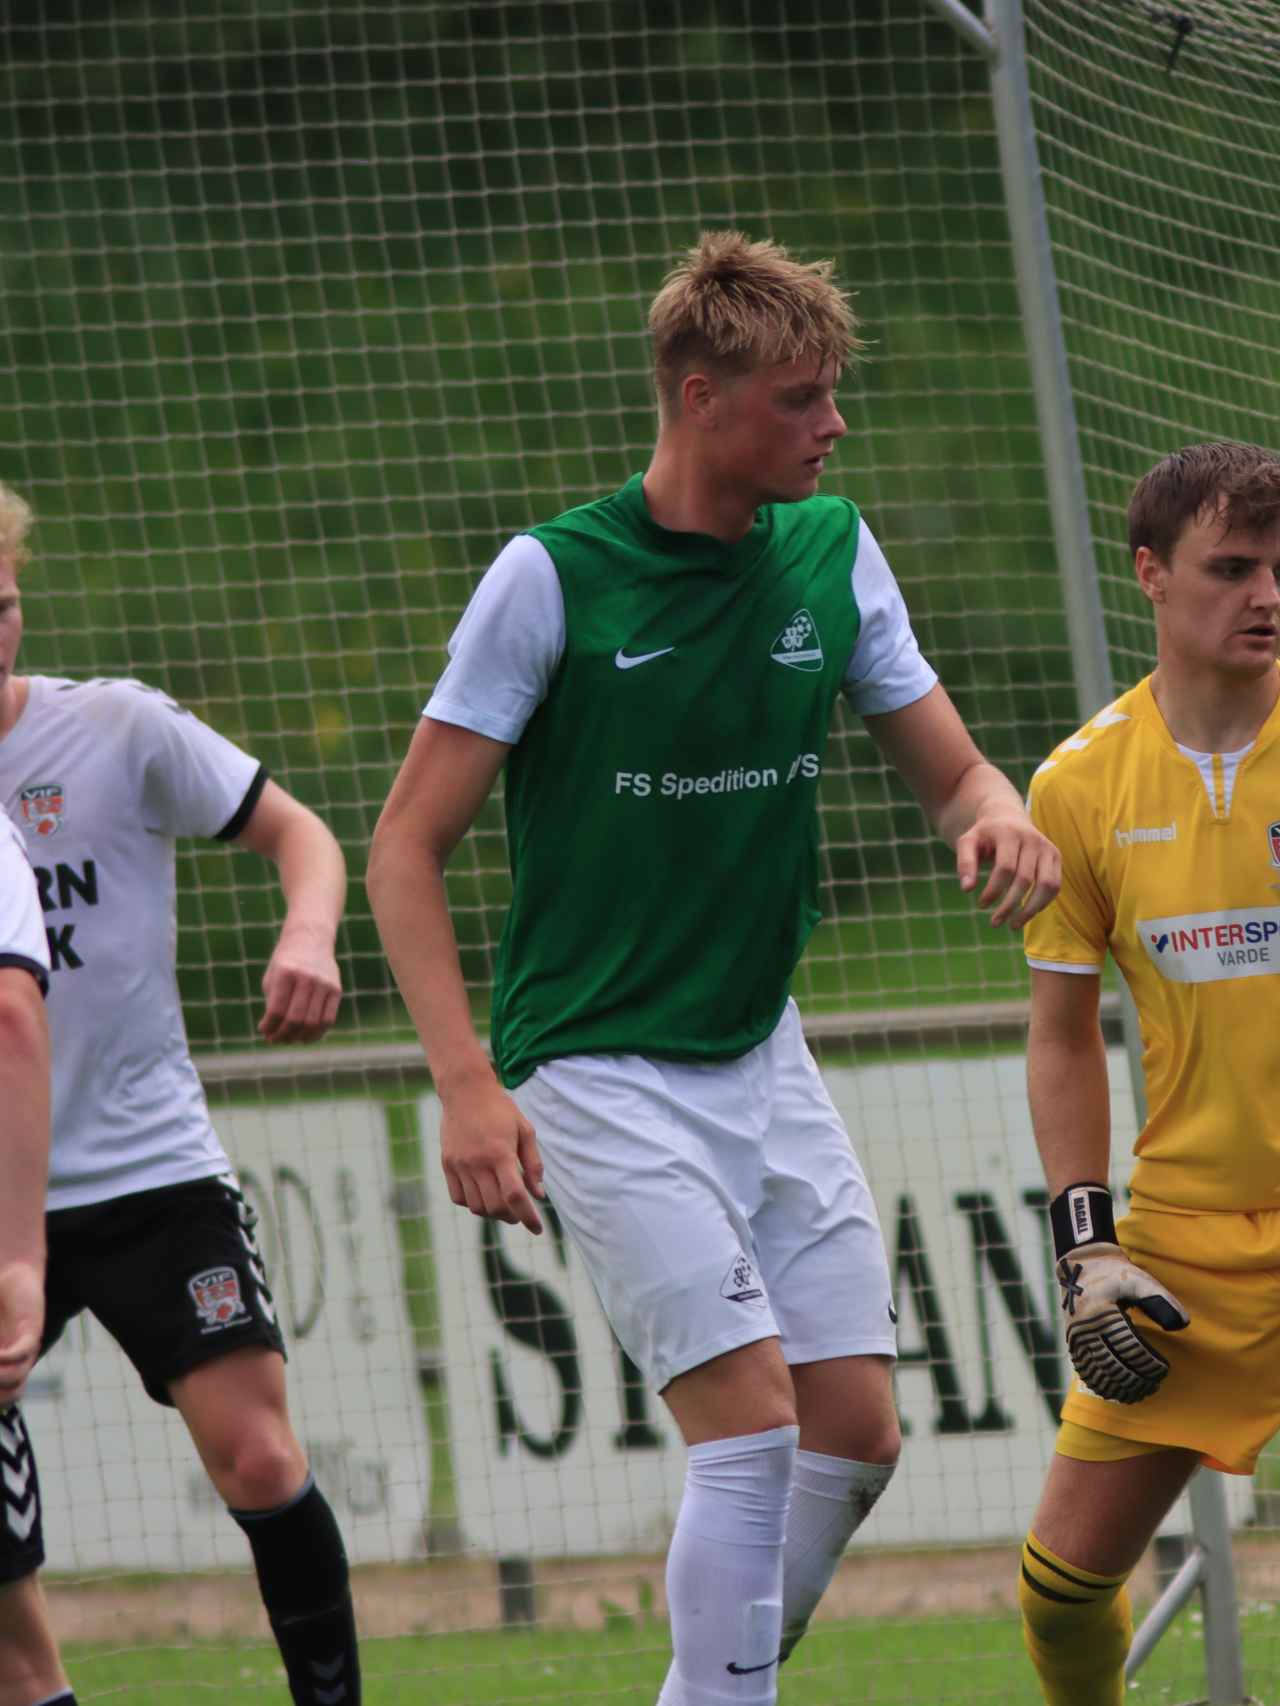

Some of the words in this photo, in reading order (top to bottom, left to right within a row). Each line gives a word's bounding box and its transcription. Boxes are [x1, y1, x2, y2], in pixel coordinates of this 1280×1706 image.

[615, 771, 652, 797] FS
[660, 766, 778, 800] Spedition
[1216, 947, 1271, 967] VARDE
